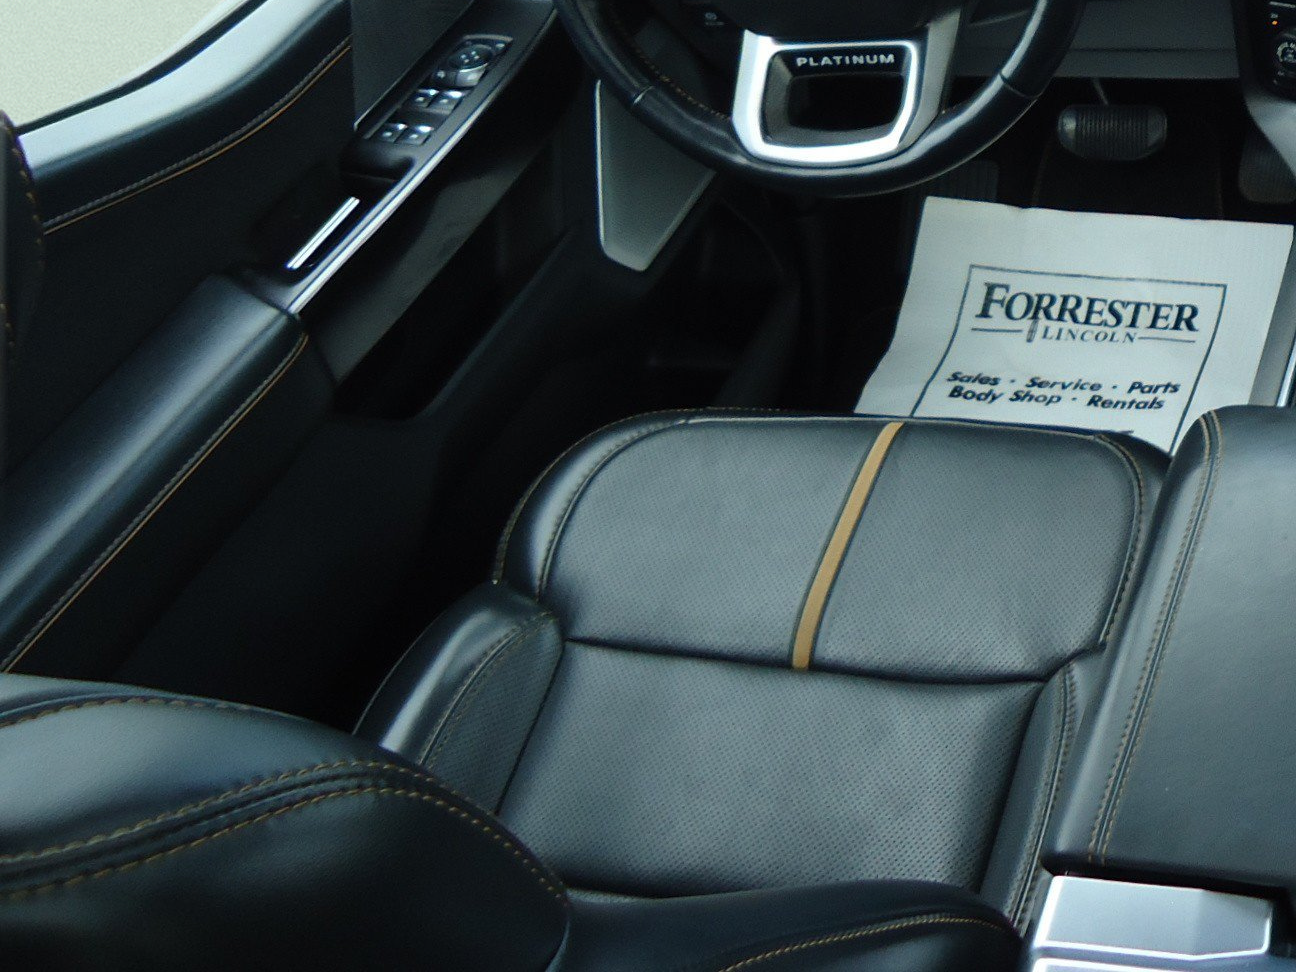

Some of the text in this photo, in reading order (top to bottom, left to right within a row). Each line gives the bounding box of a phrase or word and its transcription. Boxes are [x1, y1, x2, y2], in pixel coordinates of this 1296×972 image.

[795, 53, 895, 67] PLATINUM
[975, 281, 1199, 332] FORRESTER
[1042, 325, 1138, 344] LINCOLN
[948, 371, 1181, 394] Sales Service Parts
[948, 385, 1166, 410] Body Shop Rentals
